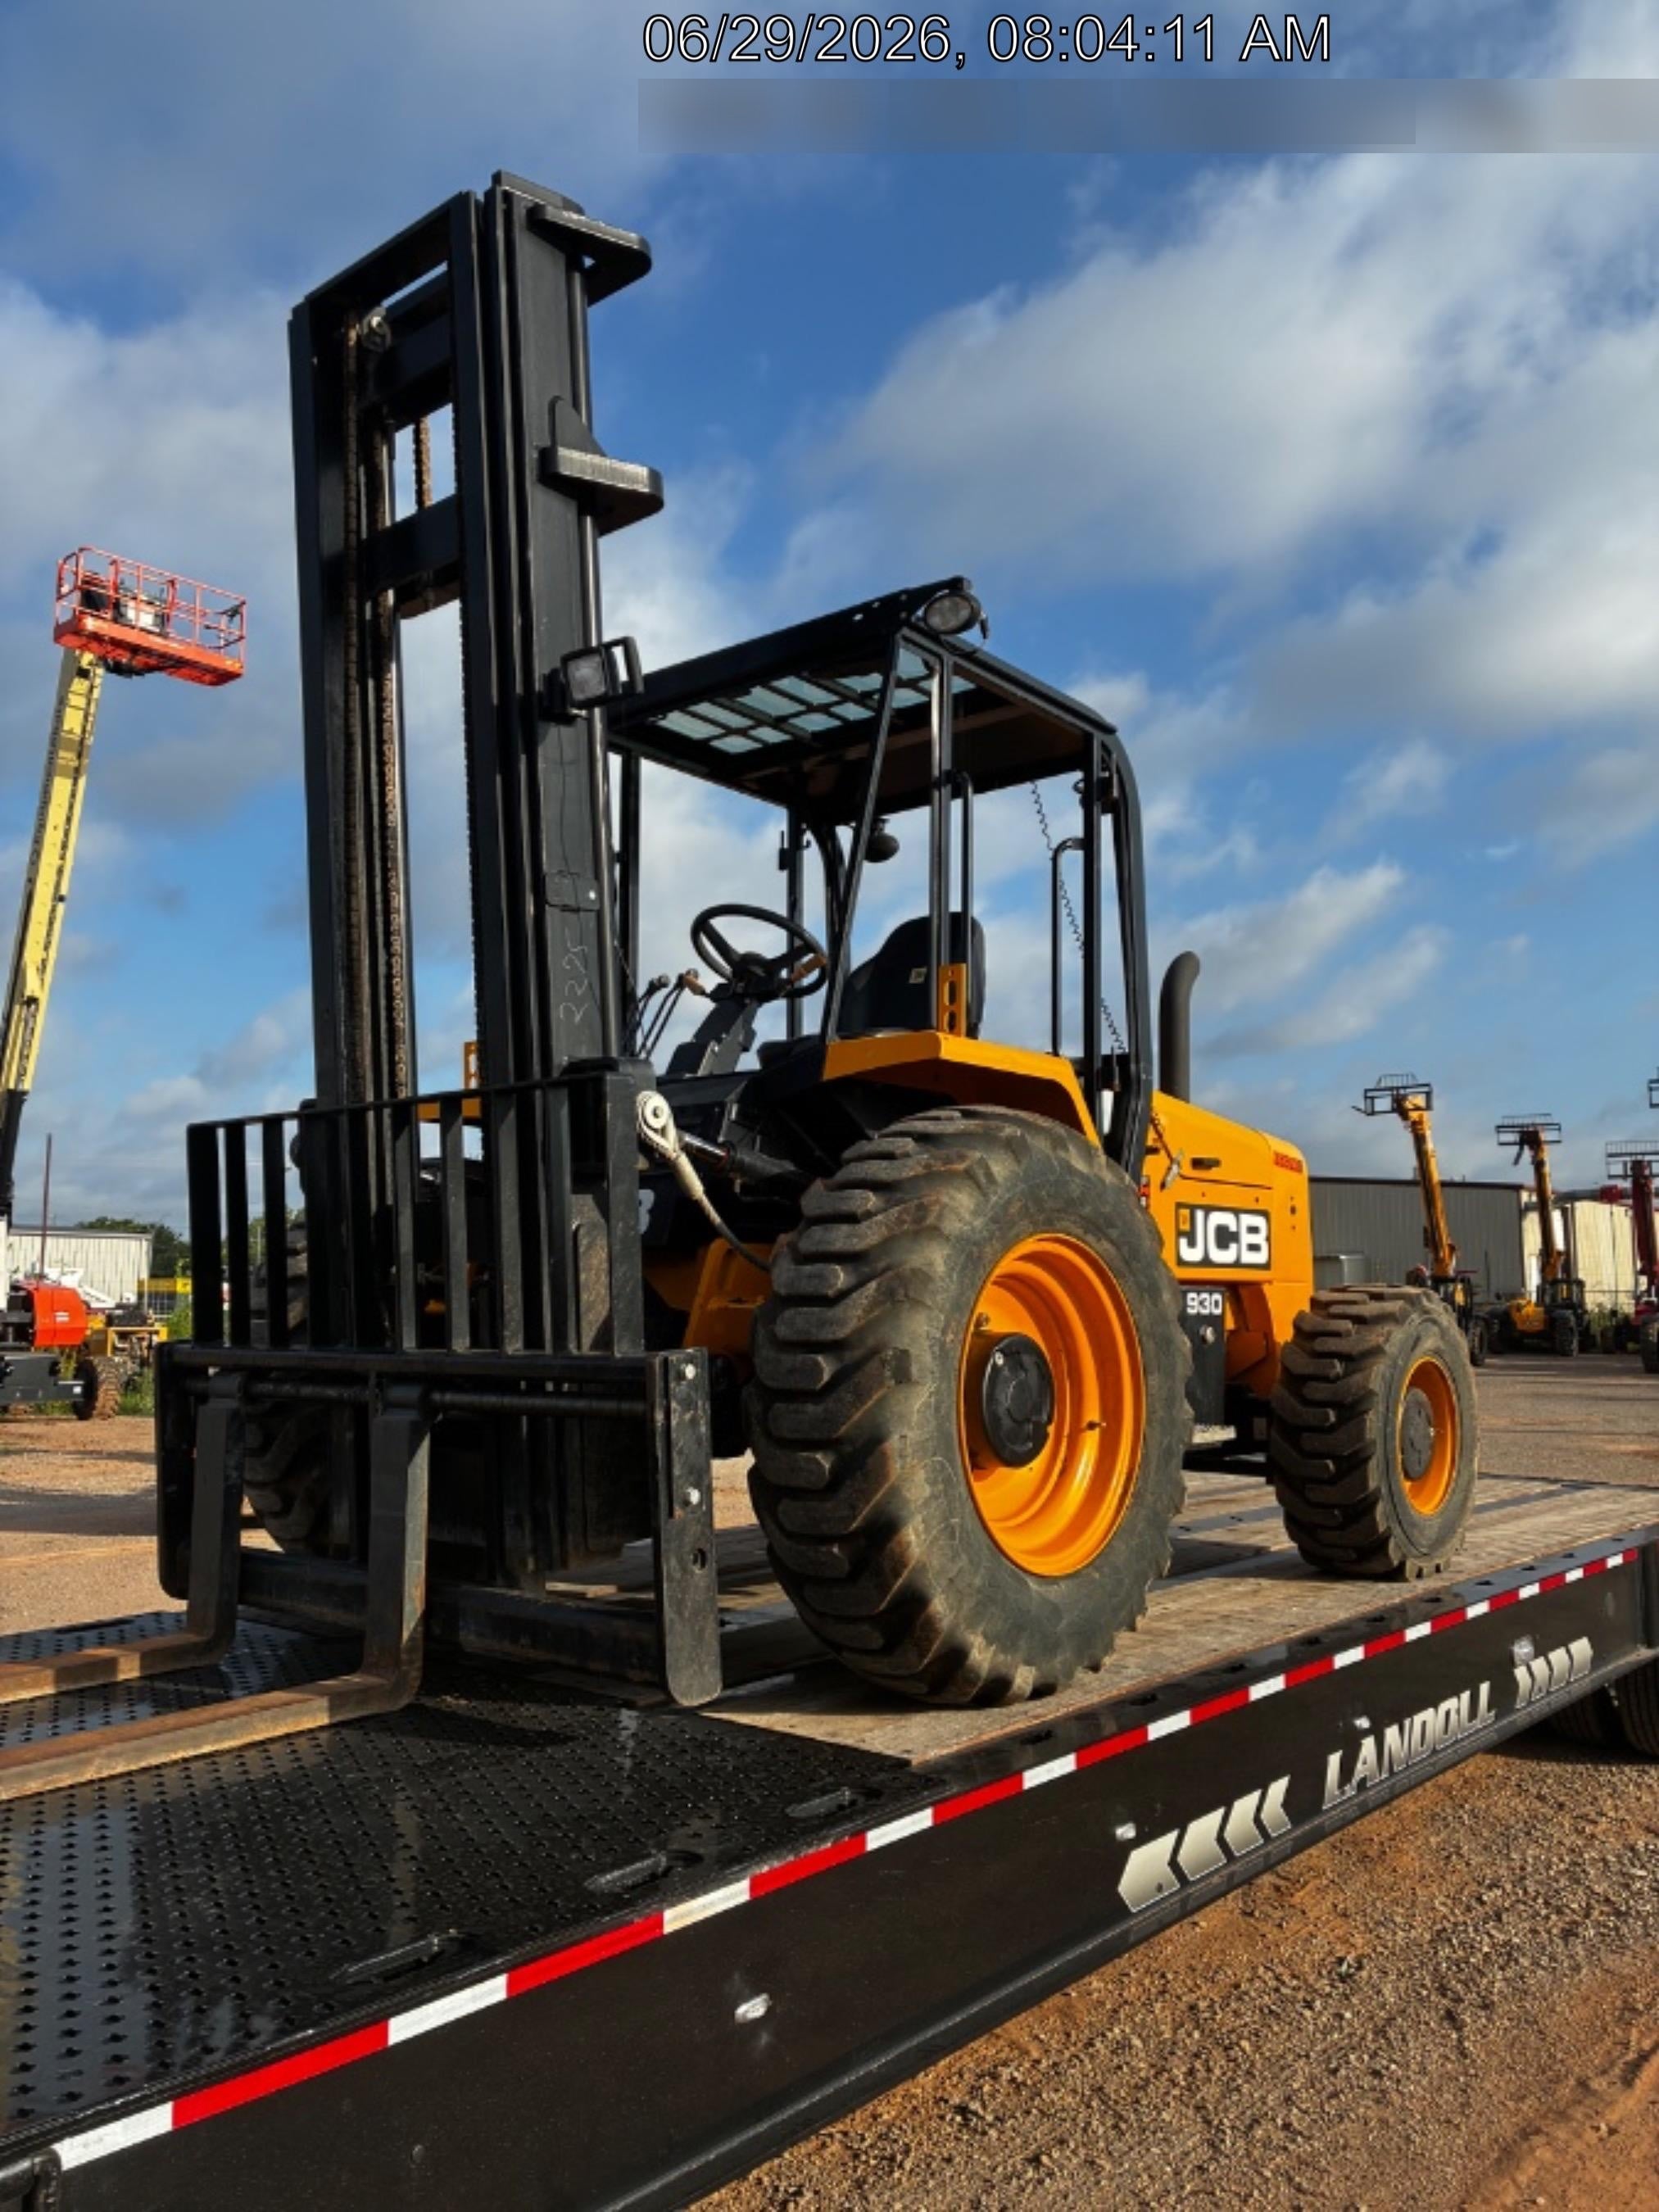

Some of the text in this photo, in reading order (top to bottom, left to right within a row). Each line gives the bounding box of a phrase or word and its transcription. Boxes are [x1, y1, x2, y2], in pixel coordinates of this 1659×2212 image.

[1179, 1209, 1269, 1263] JCB
[1186, 1292, 1222, 1316] 930
[1322, 1681, 1496, 1809] LANDOLL
